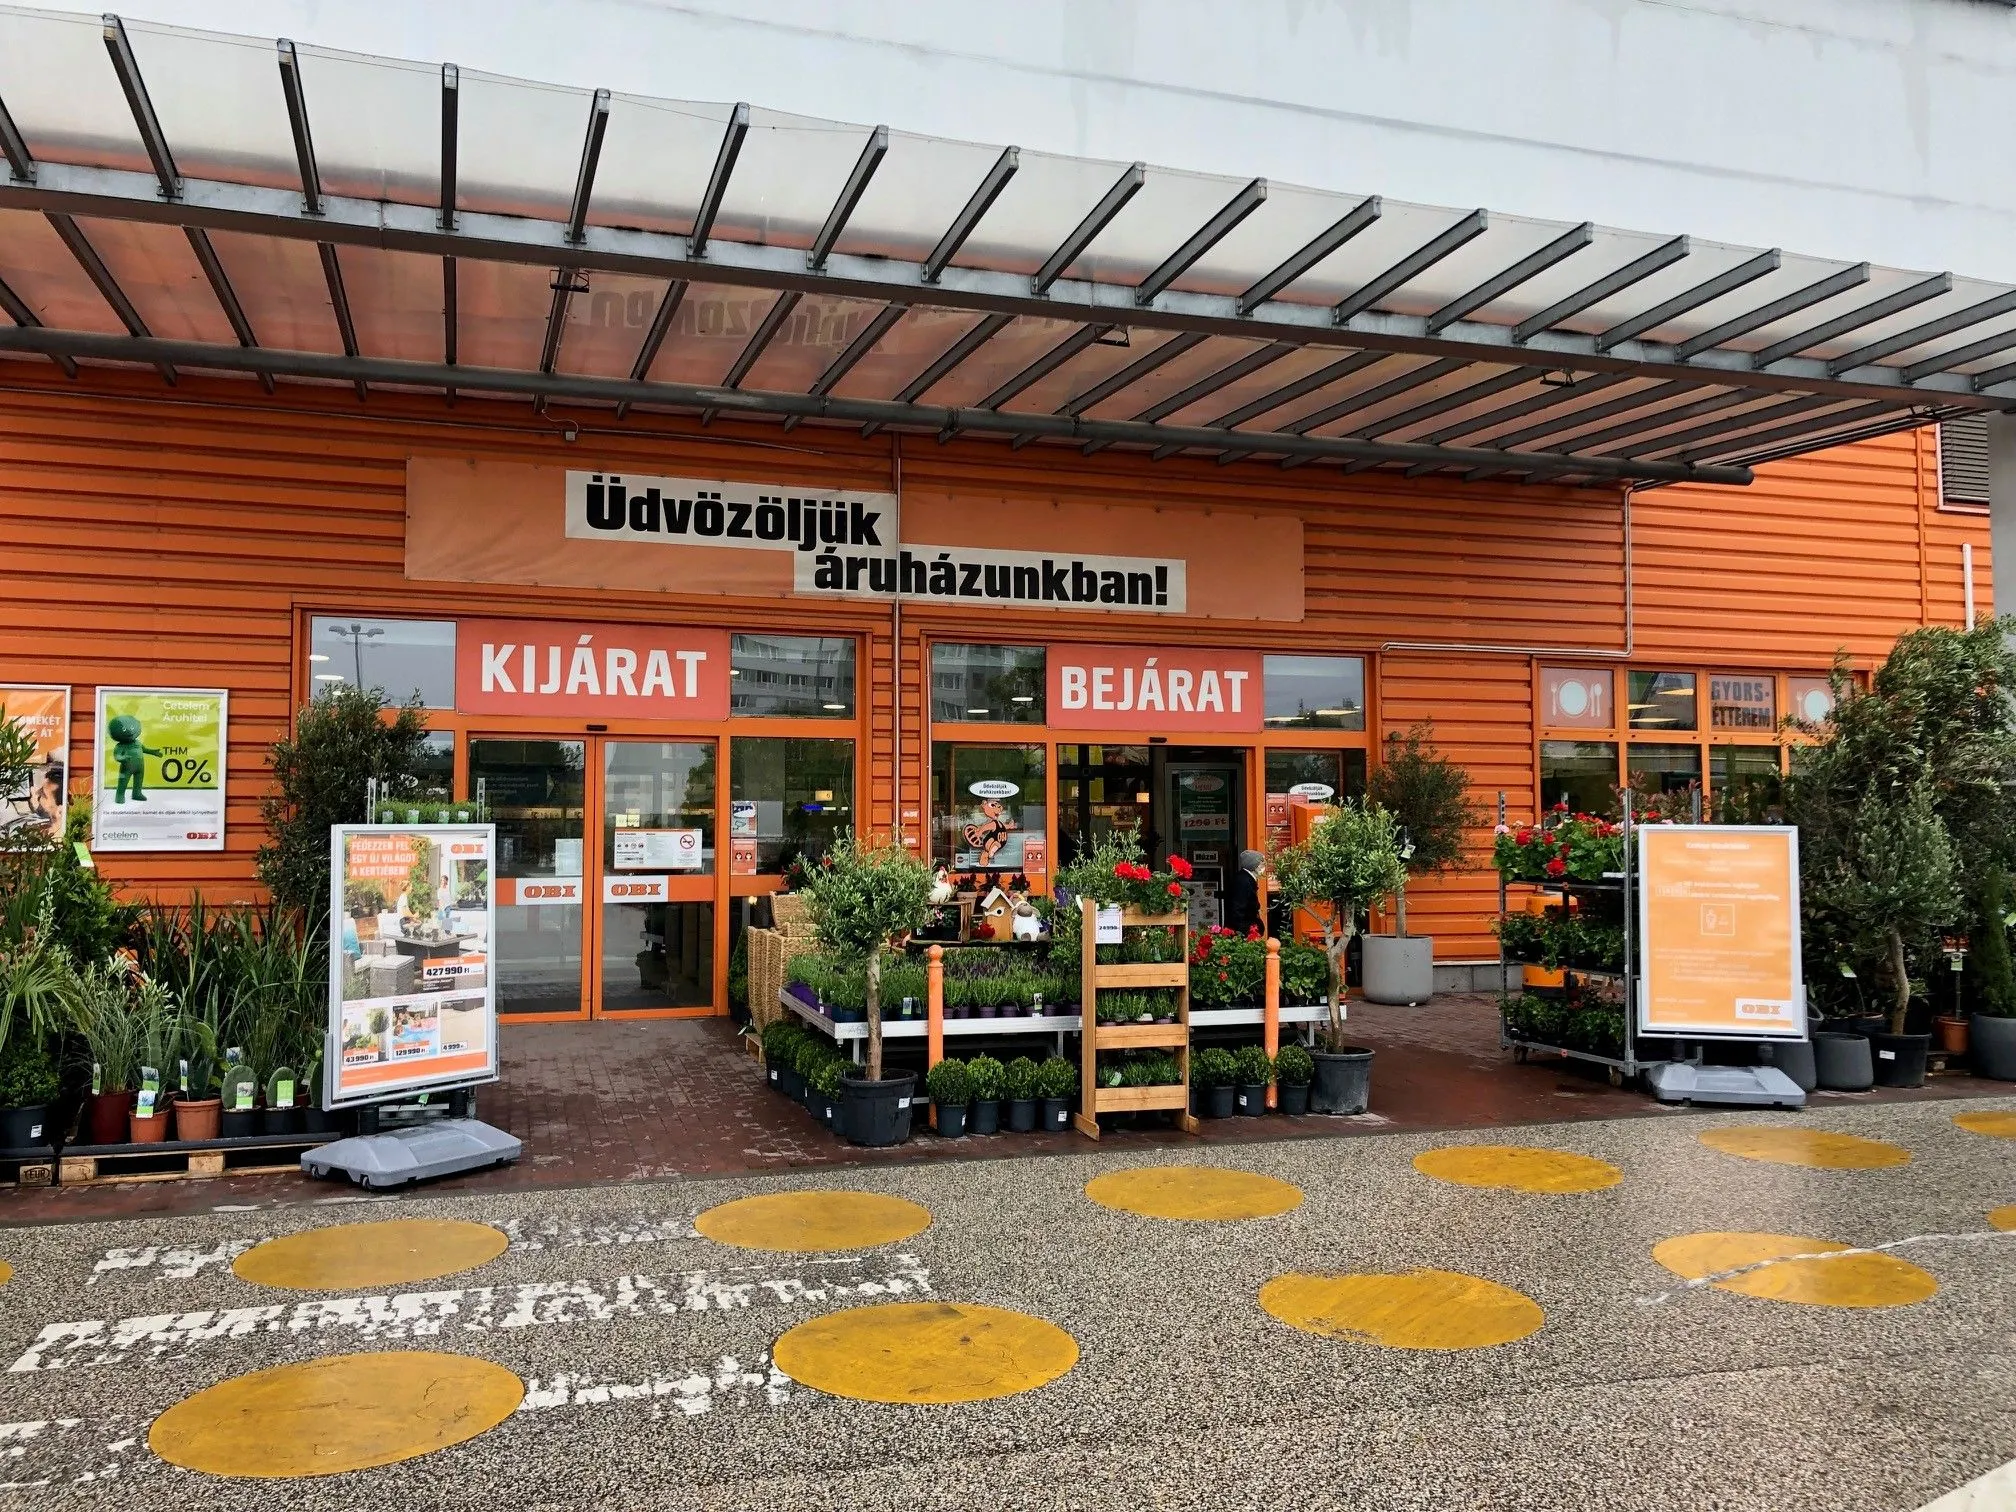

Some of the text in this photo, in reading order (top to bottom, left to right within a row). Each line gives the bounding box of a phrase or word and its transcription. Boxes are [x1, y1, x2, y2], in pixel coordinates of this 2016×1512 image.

[585, 475, 881, 552] Üdvözöljük
[814, 546, 1168, 606] áruházunkban!
[481, 635, 707, 698] KIJÁRAT
[1061, 657, 1248, 713] BEJÁRAT
[163, 701, 210, 711] Cetelem
[1712, 703, 1771, 727] ÉTTEREM
[163, 747, 188, 755] THM
[162, 758, 212, 784] 0%
[524, 885, 577, 898] OBI
[611, 884, 661, 896] OBI
[29, 1168, 47, 1179] EUR
